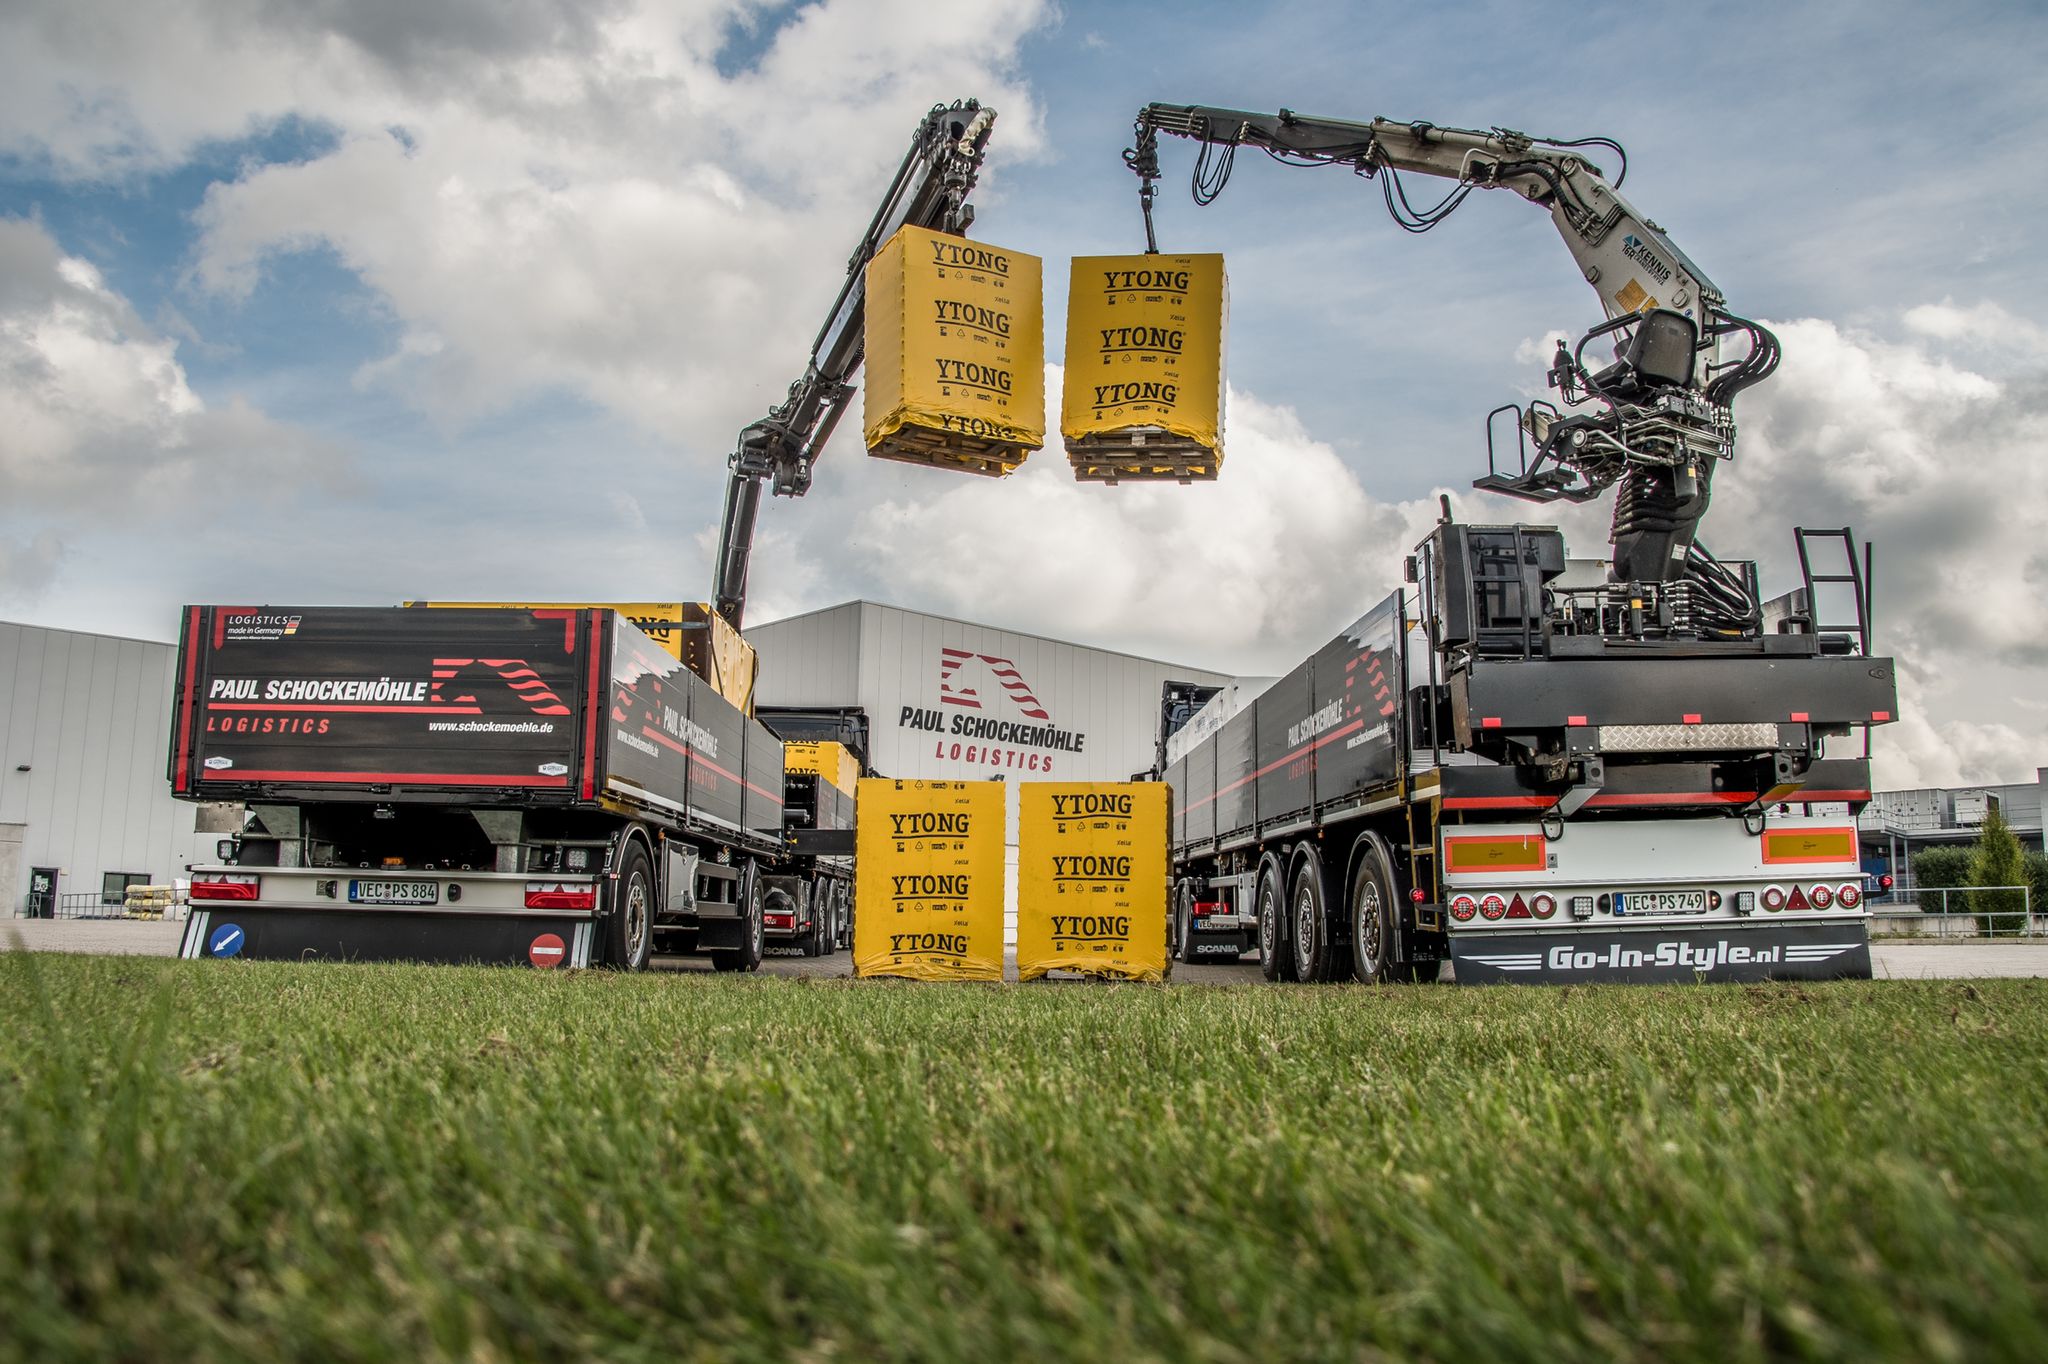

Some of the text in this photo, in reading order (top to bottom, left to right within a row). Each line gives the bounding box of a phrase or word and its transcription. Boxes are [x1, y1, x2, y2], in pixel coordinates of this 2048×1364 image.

[931, 240, 1008, 273] YTONG
[1638, 245, 1672, 280] KENNIS
[1104, 271, 1189, 289] YTONG
[935, 300, 1010, 333] YTONG
[1101, 327, 1183, 350] YTONG
[936, 359, 1011, 390] YTONG
[1094, 382, 1176, 402] YTONG
[229, 615, 288, 625] LOGISTICS
[254, 627, 284, 636] Germany
[209, 677, 428, 702] PAUL SCHOCKEMÖHLE
[207, 717, 330, 733] LOGISTICS
[428, 721, 553, 733] www.schockemoehle.de
[899, 706, 1085, 753] PAUL SCHOCKEMÖHLE
[935, 741, 1053, 773] LOGISTICS
[1051, 794, 1132, 814] YTONG
[890, 812, 969, 834] YTONG
[1052, 856, 1130, 876] YTONG
[359, 882, 434, 898] VEC PS 884
[892, 875, 968, 895] YTONG
[1624, 893, 1703, 910] VEC PS 749
[1051, 916, 1129, 936] YTONG
[763, 947, 805, 956] SCANIA
[890, 933, 967, 953] YTONG
[1197, 944, 1239, 953] SCANIA
[1549, 941, 1780, 971] Go-In-Style.nl
